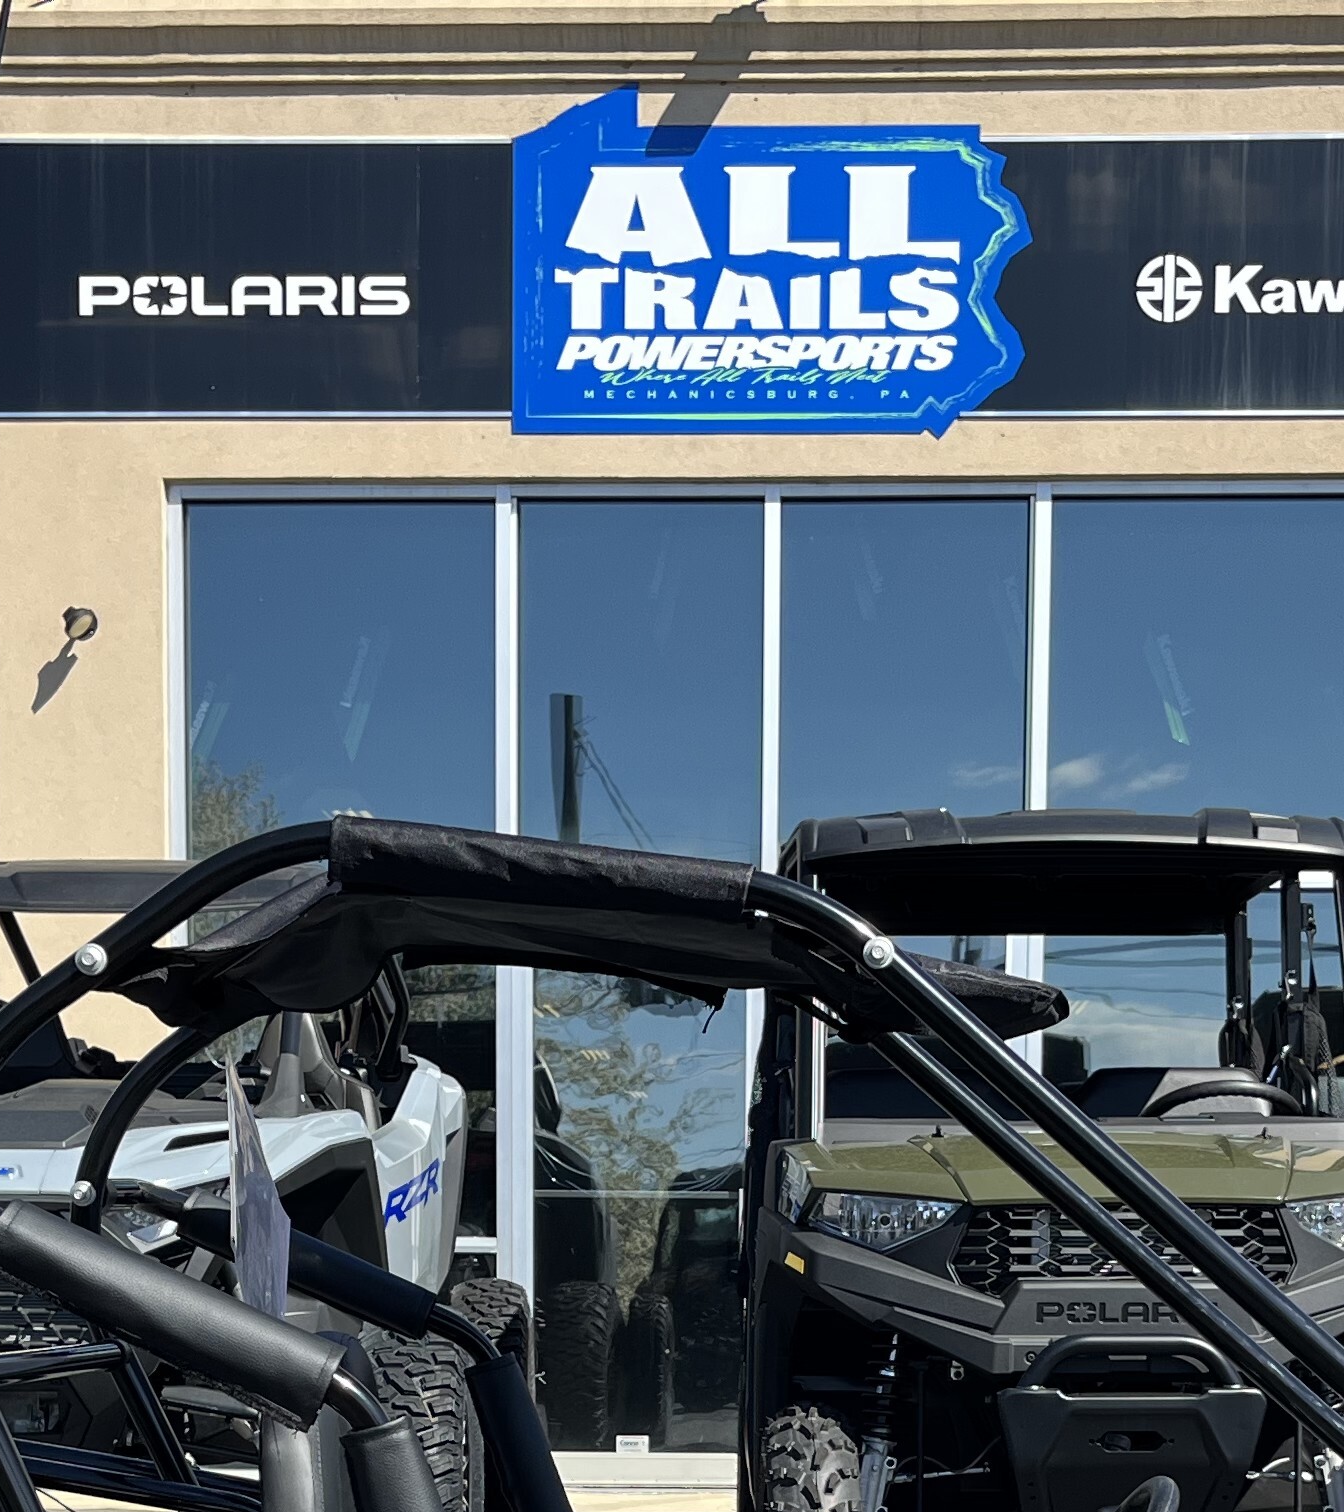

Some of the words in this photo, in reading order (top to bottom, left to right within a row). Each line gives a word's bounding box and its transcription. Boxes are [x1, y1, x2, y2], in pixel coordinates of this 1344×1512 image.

[565, 165, 960, 267] ALL
[78, 275, 410, 317] POLARIS
[554, 266, 960, 331] TRAILS
[556, 335, 958, 371] POWERSPORTS
[600, 367, 687, 386] Where
[690, 367, 742, 386] All
[751, 366, 824, 386] Trails
[880, 389, 911, 400] PA
[383, 1158, 440, 1230] RZR
[1036, 1302, 1218, 1324] POLAR
